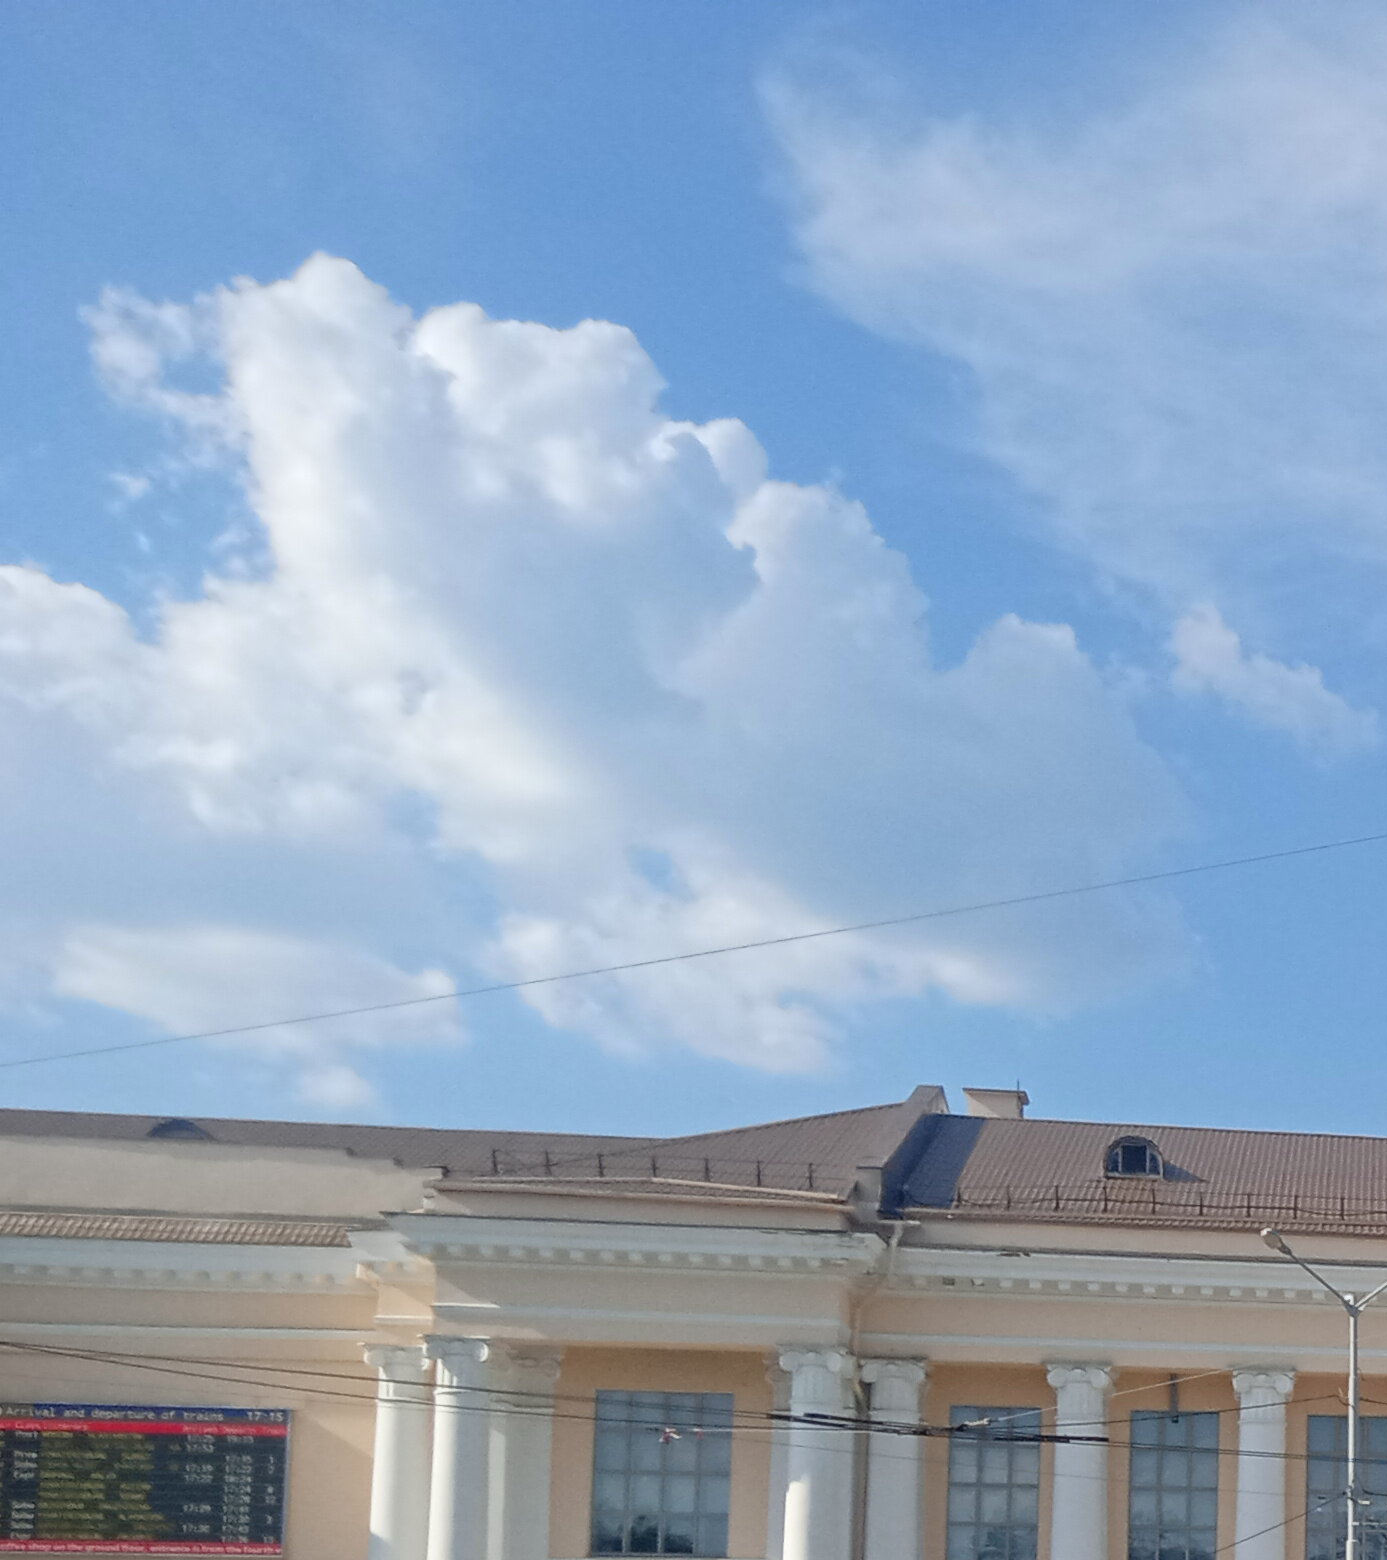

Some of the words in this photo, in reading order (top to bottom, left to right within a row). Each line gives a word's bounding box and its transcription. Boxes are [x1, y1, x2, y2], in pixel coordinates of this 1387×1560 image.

[5, 1406, 56, 1418] Arrival
[63, 1408, 86, 1418] and
[91, 1408, 156, 1420] departure
[160, 1410, 176, 1420] of
[183, 1410, 224, 1421] trains
